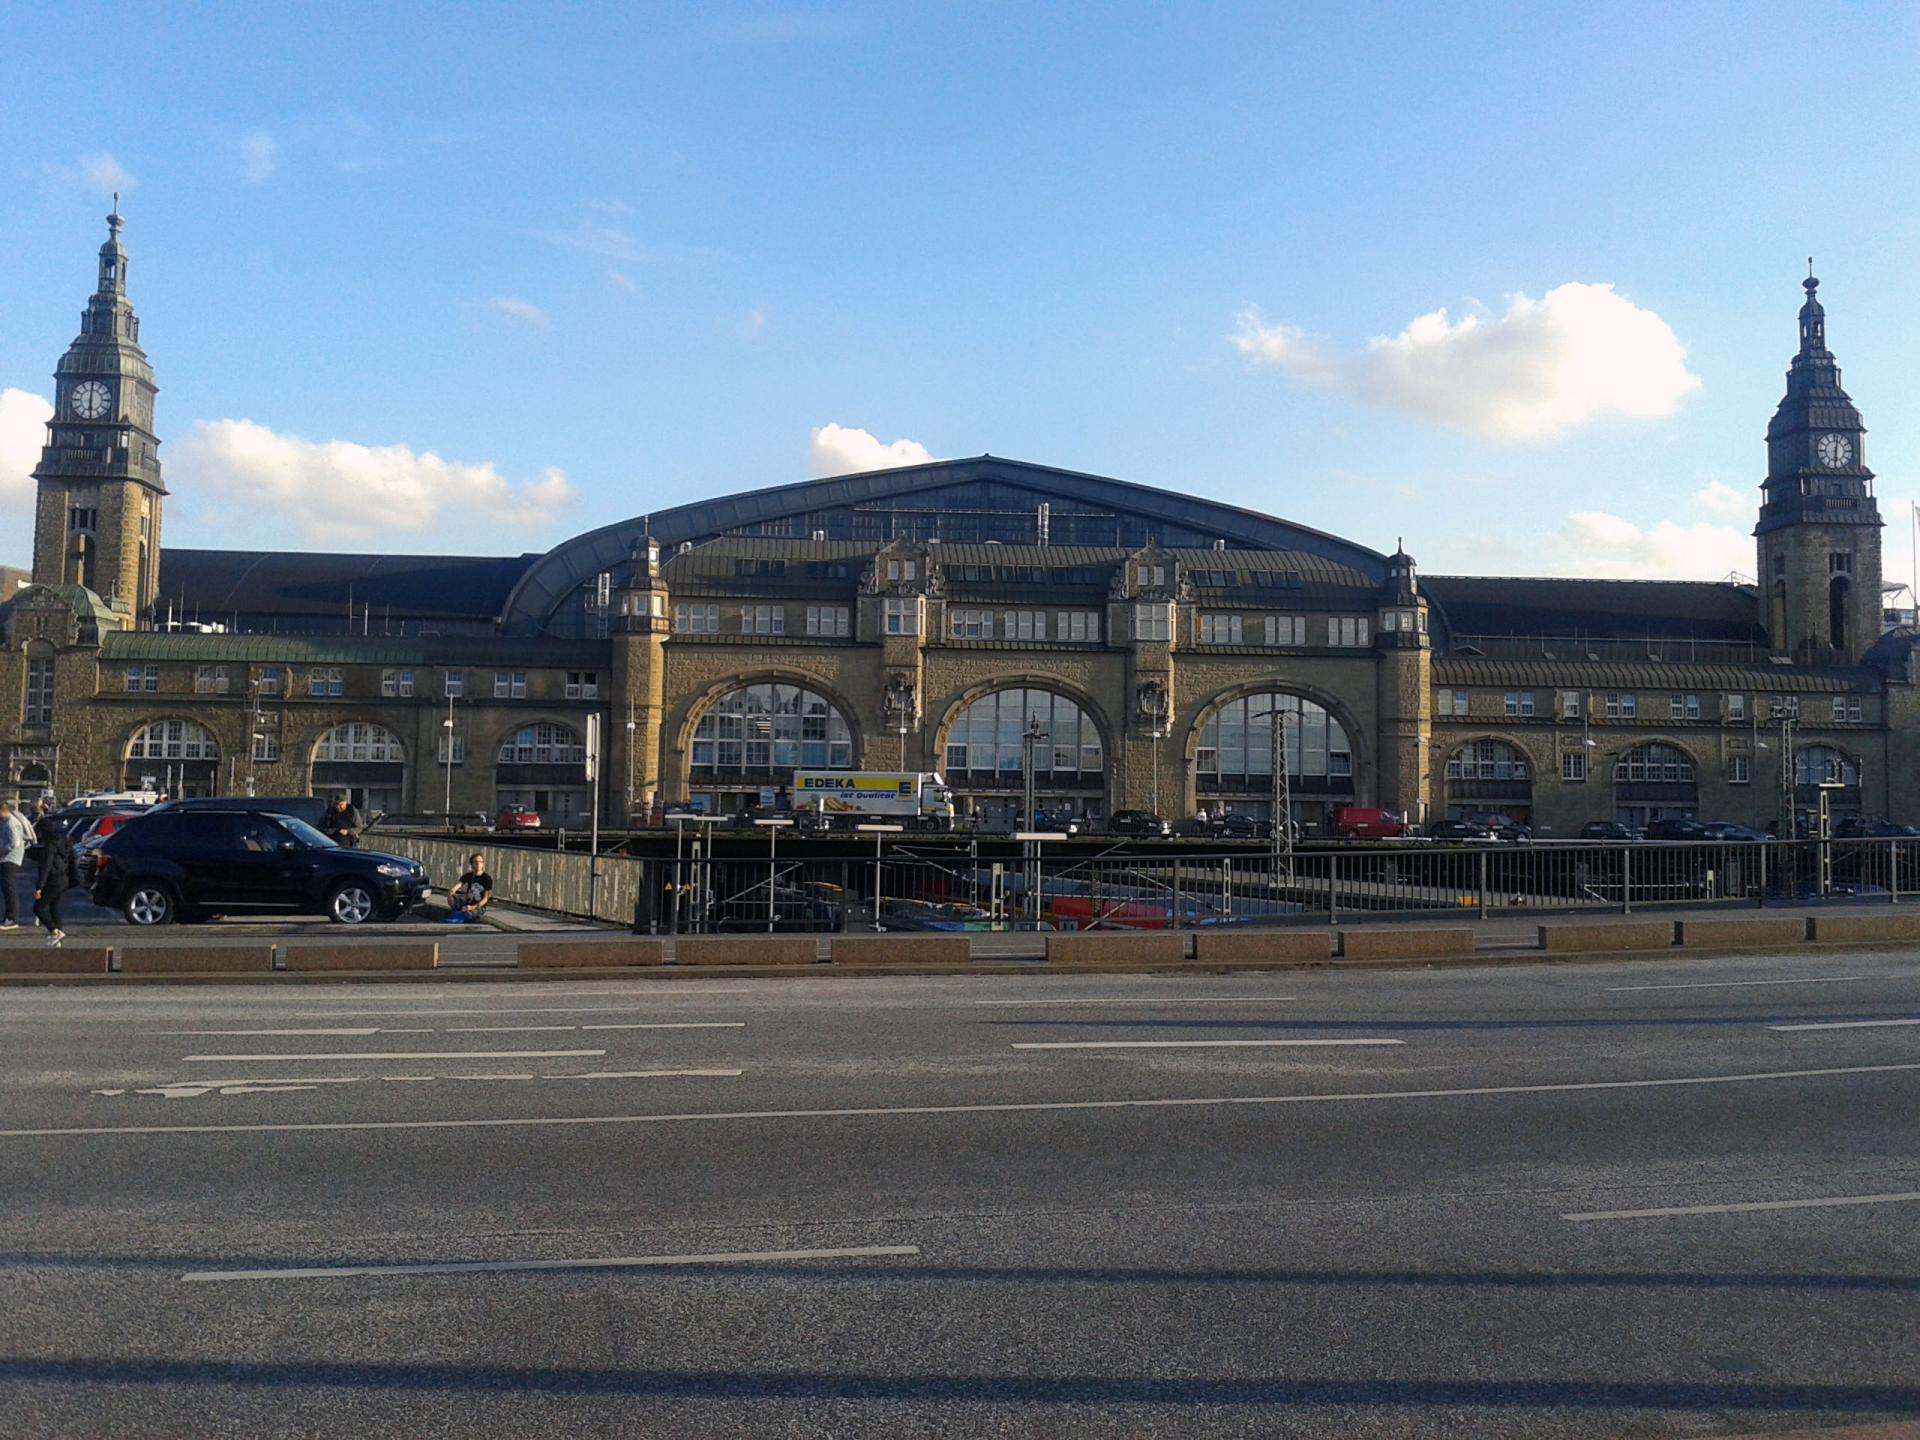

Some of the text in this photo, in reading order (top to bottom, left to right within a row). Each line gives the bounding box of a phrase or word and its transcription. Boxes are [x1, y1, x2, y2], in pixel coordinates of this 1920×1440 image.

[804, 778, 856, 788] EDEKA
[899, 781, 911, 793] E
[840, 791, 854, 799] ist
